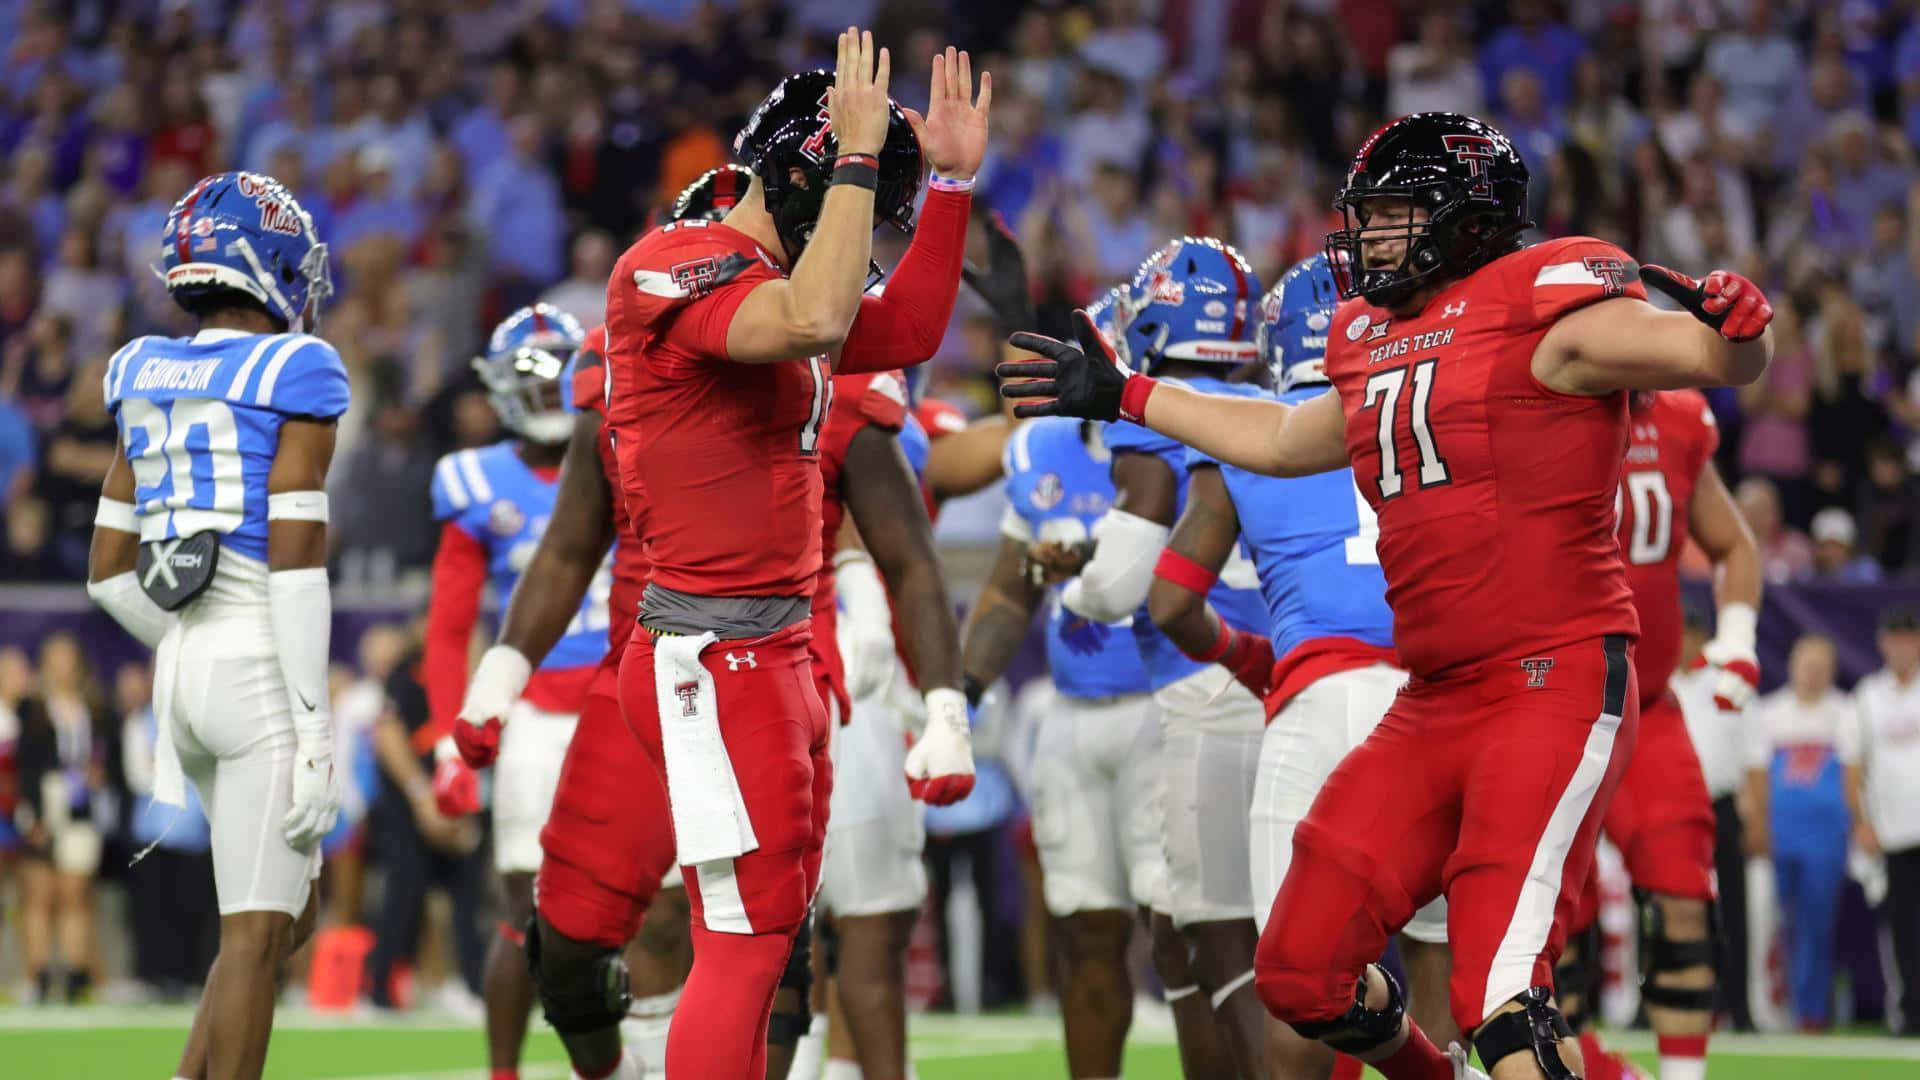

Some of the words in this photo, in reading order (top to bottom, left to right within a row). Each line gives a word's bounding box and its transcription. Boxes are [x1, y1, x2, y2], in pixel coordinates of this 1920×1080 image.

[256, 200, 300, 237] Miss
[1368, 338, 1409, 365] TEXAS
[1413, 327, 1455, 352] TECH
[121, 398, 244, 543] 20
[1362, 357, 1452, 500] 71
[1614, 471, 1673, 565] 0
